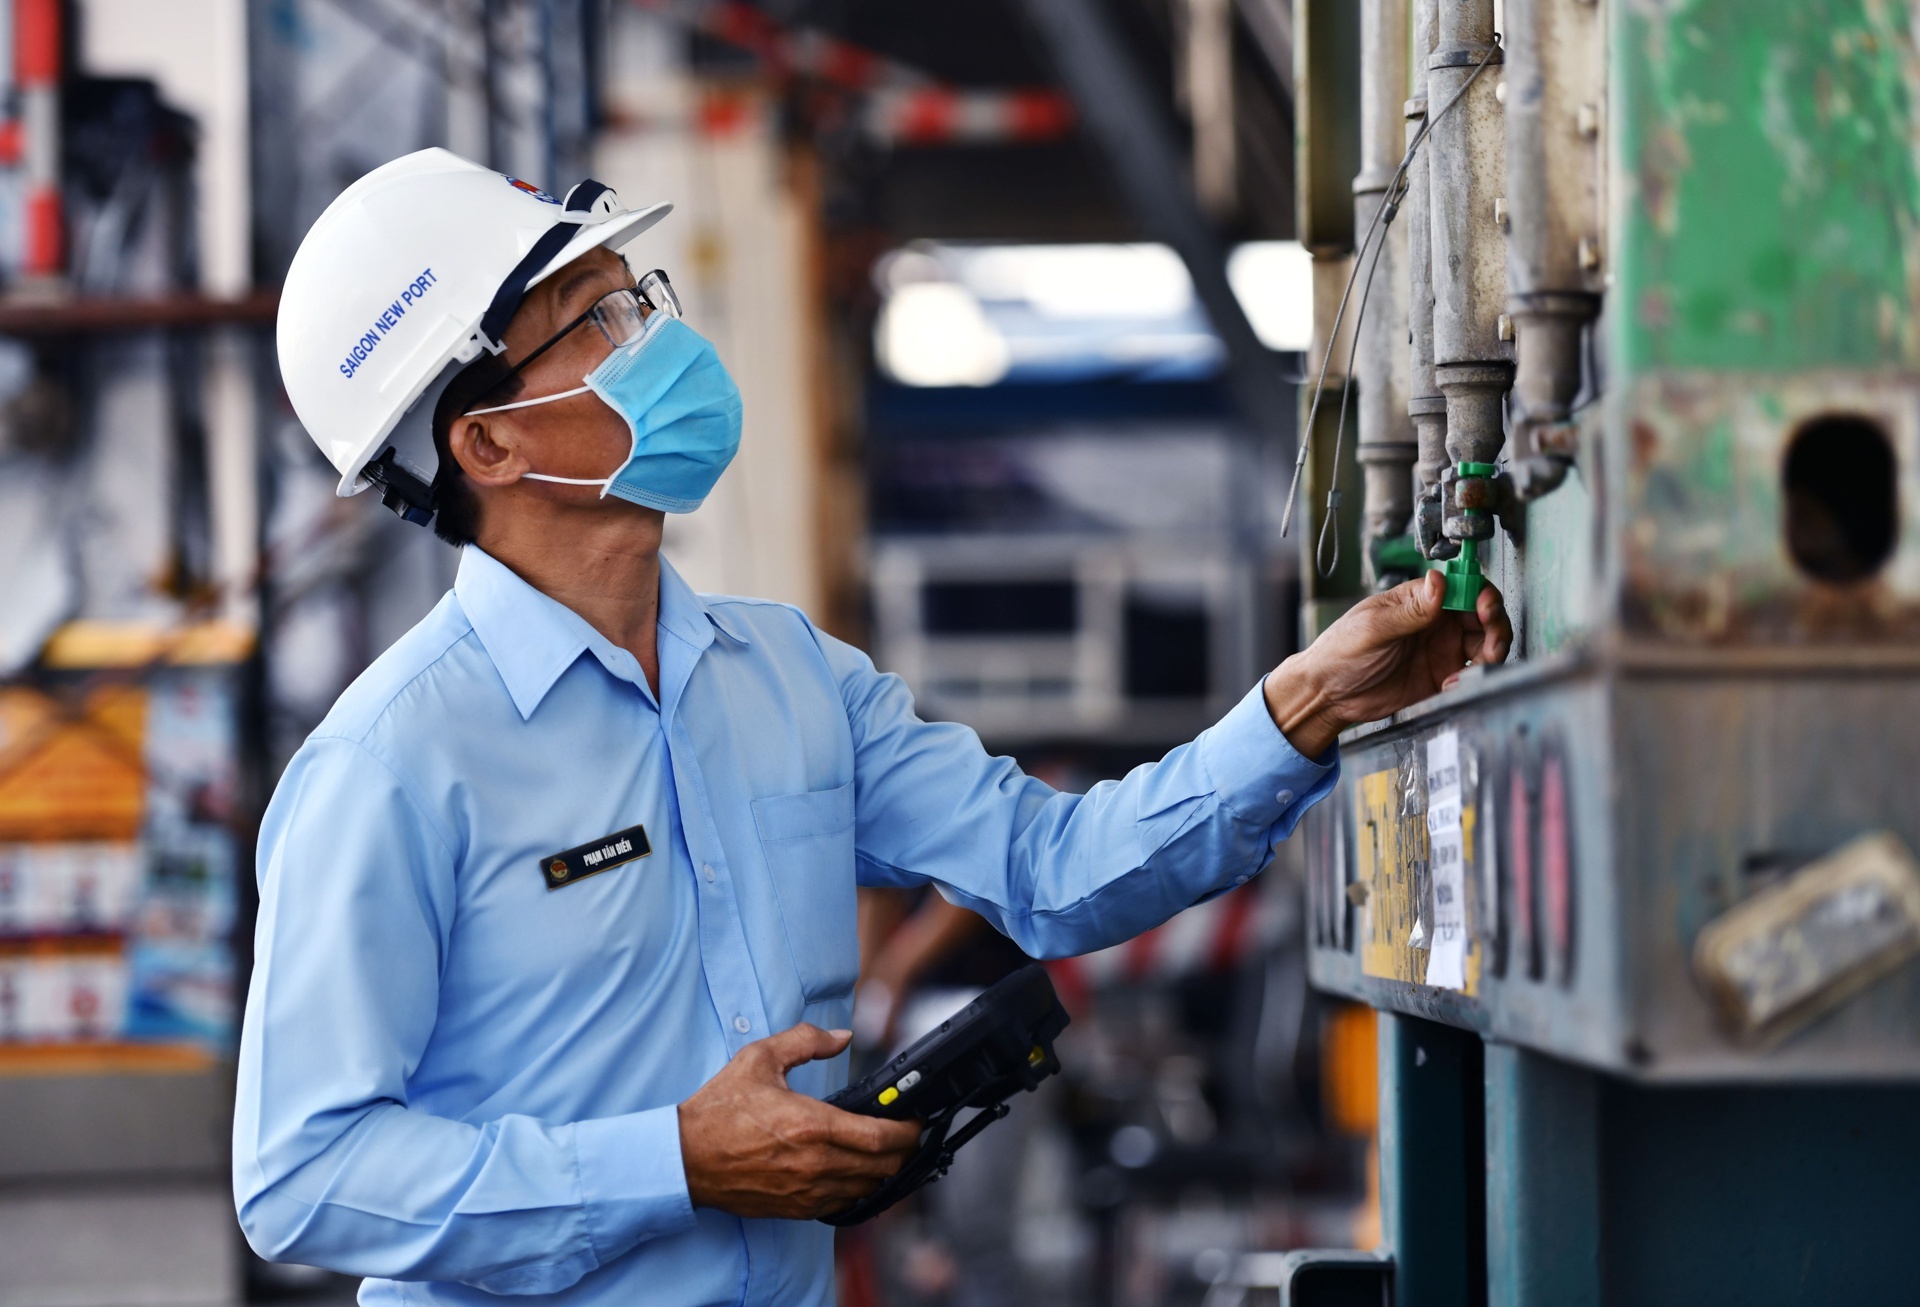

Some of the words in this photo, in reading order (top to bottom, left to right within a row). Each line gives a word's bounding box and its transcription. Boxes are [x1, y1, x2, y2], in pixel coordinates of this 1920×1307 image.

[339, 329, 381, 379] SAIGON
[375, 300, 406, 335] NEW
[401, 268, 437, 306] PORT
[583, 849, 603, 866] PHẠM
[601, 844, 617, 860] VĂN
